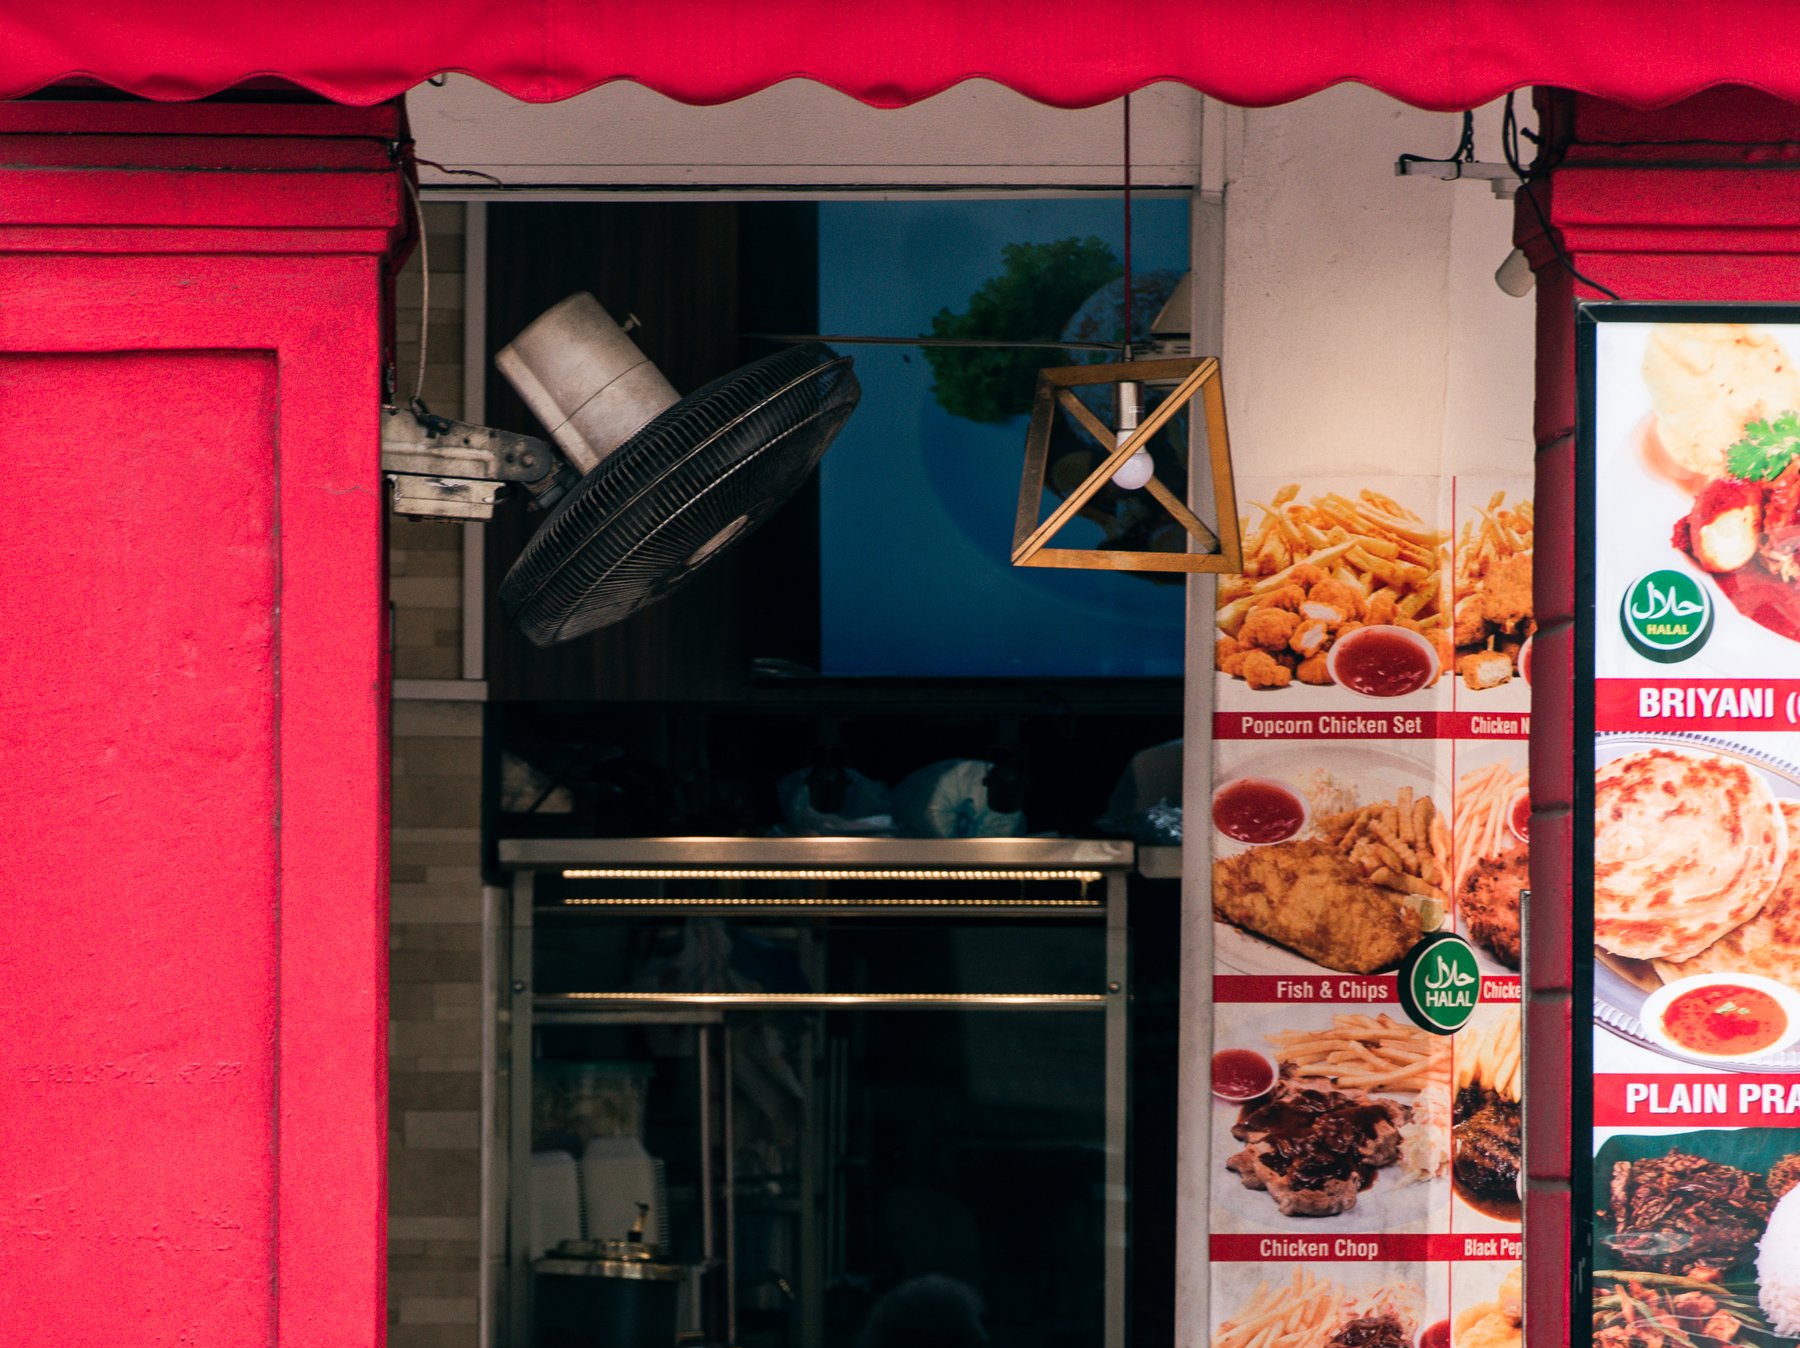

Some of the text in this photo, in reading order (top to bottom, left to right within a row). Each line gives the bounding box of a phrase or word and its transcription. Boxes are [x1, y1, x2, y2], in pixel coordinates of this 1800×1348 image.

[1632, 581, 1704, 619] حلال
[1646, 624, 1689, 635] HALAL
[1639, 687, 1774, 718] BRIYANI
[1241, 716, 1422, 737] Popcorn Chicken Set
[1471, 716, 1518, 734] Chicken
[1425, 955, 1476, 989] حلال
[1277, 981, 1388, 1002] Fish & Chips
[1426, 990, 1473, 1007] HALAL
[1483, 981, 1521, 999] Chicke
[1626, 1083, 1727, 1114] PLAIN
[1260, 1239, 1378, 1260] Chicken Chop
[1464, 1238, 1522, 1260] Black Pep
